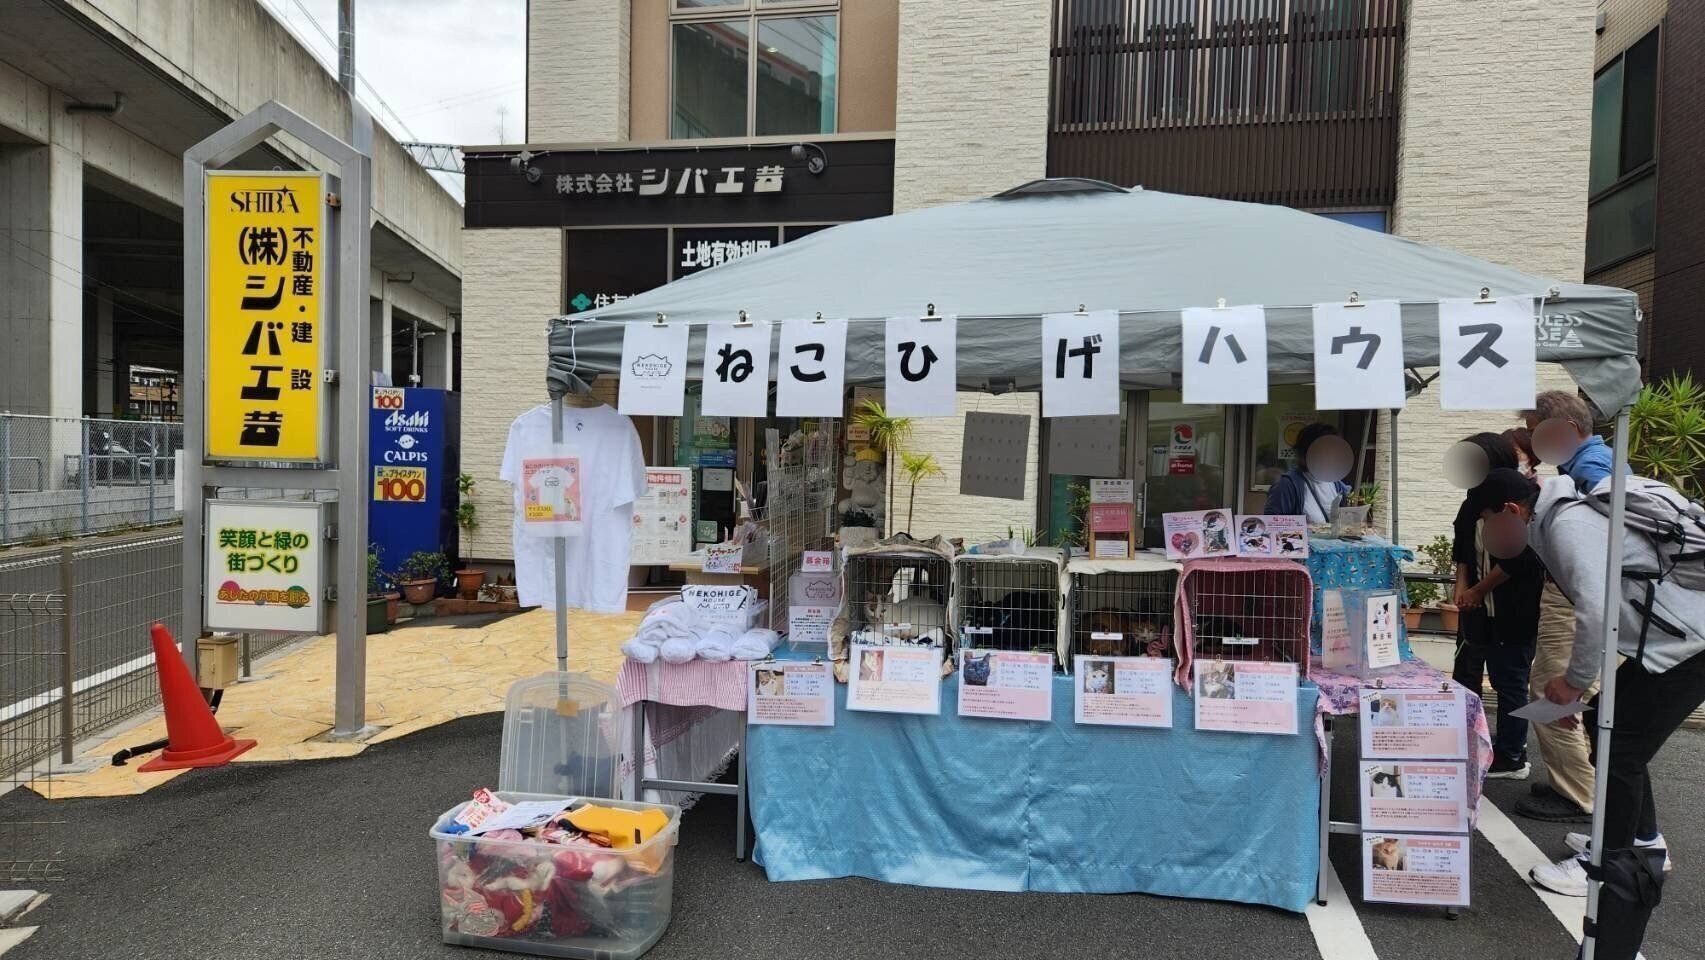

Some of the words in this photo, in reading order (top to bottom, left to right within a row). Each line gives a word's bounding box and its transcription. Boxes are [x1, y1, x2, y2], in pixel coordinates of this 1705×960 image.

[556, 165, 785, 196] 株式会社シバ工芸
[230, 189, 300, 214] SHIBA
[384, 410, 429, 427] Asahi
[384, 450, 428, 463] CALPIS
[377, 478, 425, 501] 100
[219, 529, 309, 550] 笑顔と緑の
[228, 553, 298, 573] 街づくり
